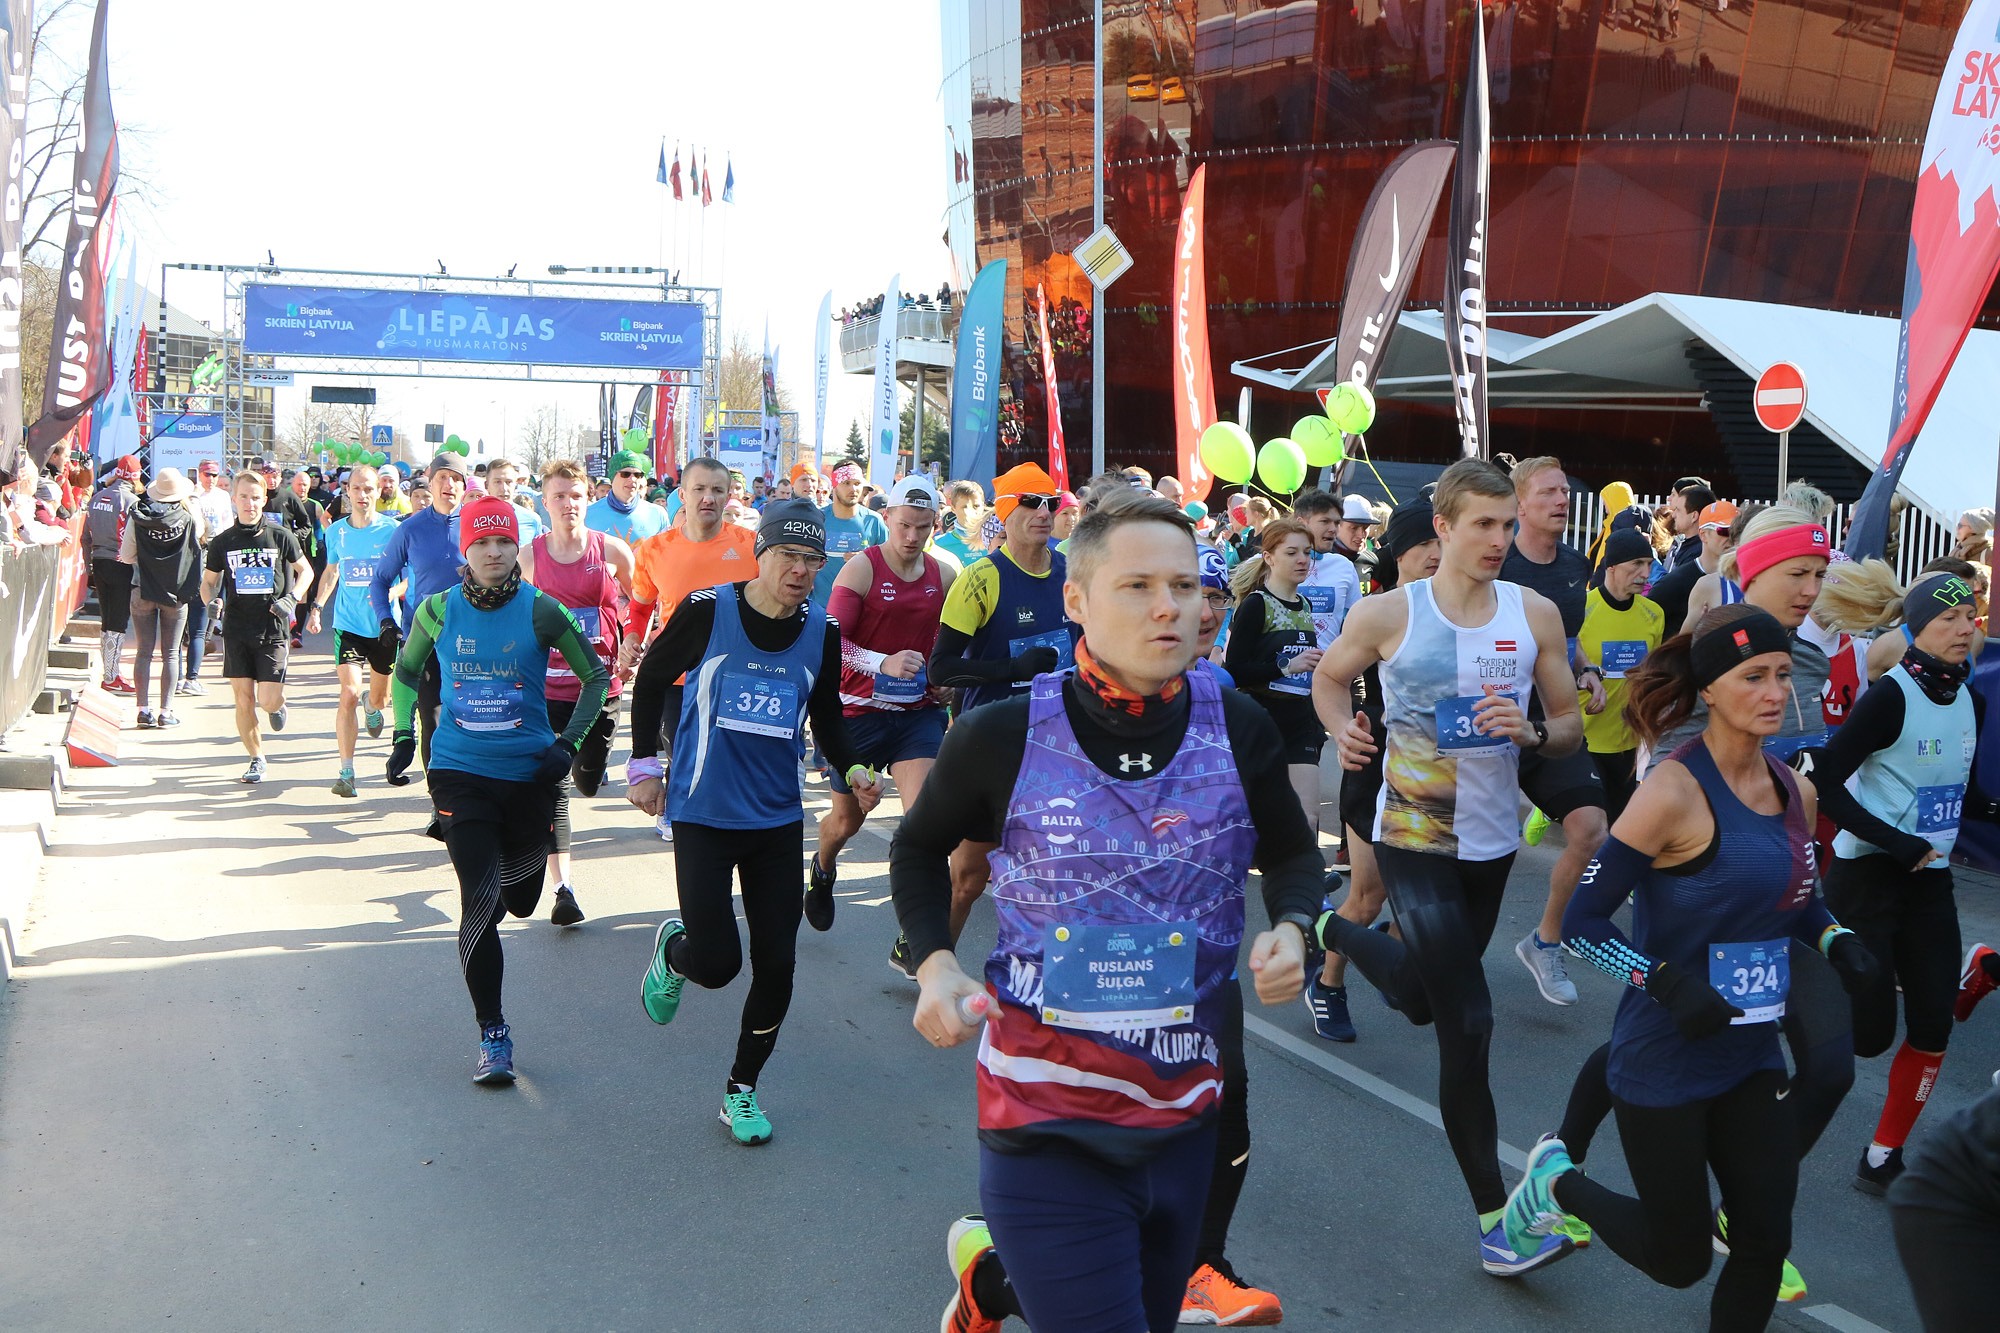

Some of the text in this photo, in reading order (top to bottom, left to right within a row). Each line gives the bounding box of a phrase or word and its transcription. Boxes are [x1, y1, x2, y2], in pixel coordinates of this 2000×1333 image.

[300, 306, 333, 317] Bigbank
[265, 317, 354, 331] SKRIEN LATVIJA
[400, 306, 555, 341] LIEPĀJAS
[633, 321, 663, 331] Bigbank
[600, 331, 683, 344] SKRIEN LATVIJA
[1358, 312, 1384, 355] IT.
[425, 339, 528, 352] PUSMARATONS
[972, 325, 988, 402] Bigbank
[883, 337, 895, 421] Bigbank
[178, 423, 212, 433] Bigbank
[741, 437, 761, 447] Bigba
[93, 502, 113, 513] LATVIA
[352, 567, 374, 577] 341
[244, 575, 266, 585] 265
[451, 662, 482, 673] RIGA
[1480, 658, 1517, 667] SKRIENAM
[1044, 688, 1054, 698] 10
[736, 692, 781, 716] 378
[1188, 726, 1198, 735] 10
[1045, 734, 1057, 748] 10
[1205, 732, 1215, 742] 10
[1067, 742, 1078, 755] 10
[1186, 739, 1195, 748] 10
[1193, 763, 1205, 774] 10
[1217, 758, 1228, 770] 10
[1097, 775, 1105, 783] 10
[1200, 776, 1209, 786] 10
[1083, 782, 1092, 791] 10
[1183, 781, 1191, 790] 10
[1067, 788, 1076, 797] 10
[1018, 804, 1027, 813] 10
[1035, 800, 1044, 810] 10
[1933, 799, 1962, 822] 318
[1041, 815, 1083, 827] BALTA
[1201, 828, 1210, 838] 10
[1186, 834, 1194, 843] 10
[1077, 839, 1090, 853] 10
[1105, 838, 1119, 852] 10
[1133, 840, 1146, 854] 10
[1157, 843, 1170, 857] 10
[1171, 841, 1179, 851] 10
[1029, 846, 1039, 860] 10
[1141, 858, 1150, 867] 10
[1124, 864, 1134, 874] 10
[1220, 862, 1232, 874] 10
[1047, 869, 1055, 878] 10
[1065, 869, 1074, 879] 10
[1083, 872, 1092, 882] 10
[1108, 871, 1118, 882] 10
[1075, 886, 1085, 896] 10
[1117, 884, 1127, 894] 10
[1027, 893, 1034, 902] 10
[1059, 891, 1067, 901] 10
[1132, 892, 1142, 902] 10
[1161, 910, 1171, 920] 10
[1191, 907, 1200, 918] 10
[1089, 959, 1154, 973] RUSLANS
[1732, 964, 1779, 996] 324
[1151, 1027, 1201, 1064] KLUBS
